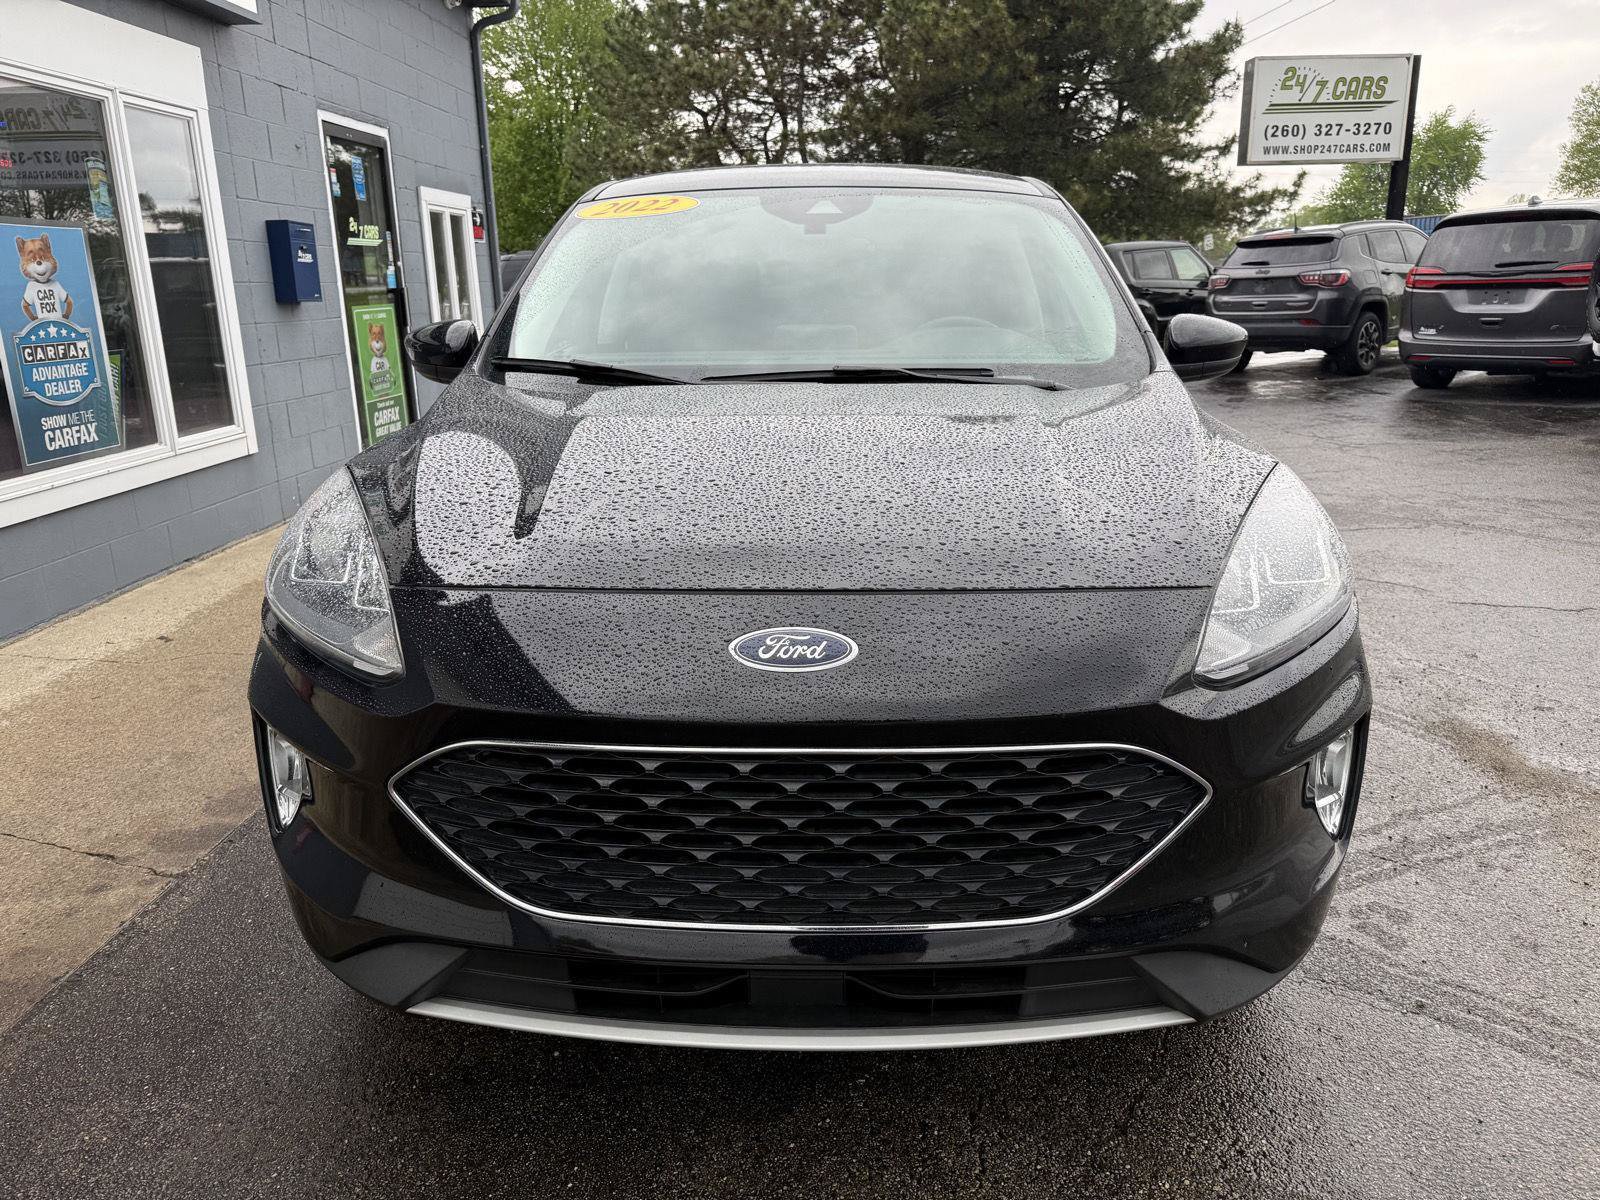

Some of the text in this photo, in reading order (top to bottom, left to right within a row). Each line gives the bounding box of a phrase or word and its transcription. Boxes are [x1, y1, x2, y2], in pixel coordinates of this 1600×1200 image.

[1331, 76, 1389, 100] CARS
[1264, 122, 1392, 140] (260) 327-3270
[1262, 142, 1391, 155] WWW.SHOP247CARS.COM
[590, 199, 680, 216] 2022
[36, 289, 56, 302] CAR
[40, 302, 58, 314] FOX
[23, 342, 90, 362] CARFAX
[32, 363, 89, 382] ADVANTAGE
[44, 379, 83, 397] DEALER
[41, 409, 96, 430] SHOW ME THE
[374, 406, 399, 426] CARFAX
[44, 422, 99, 451] CARFAX
[375, 426, 389, 438] GREAT
[758, 634, 828, 659] Ford
